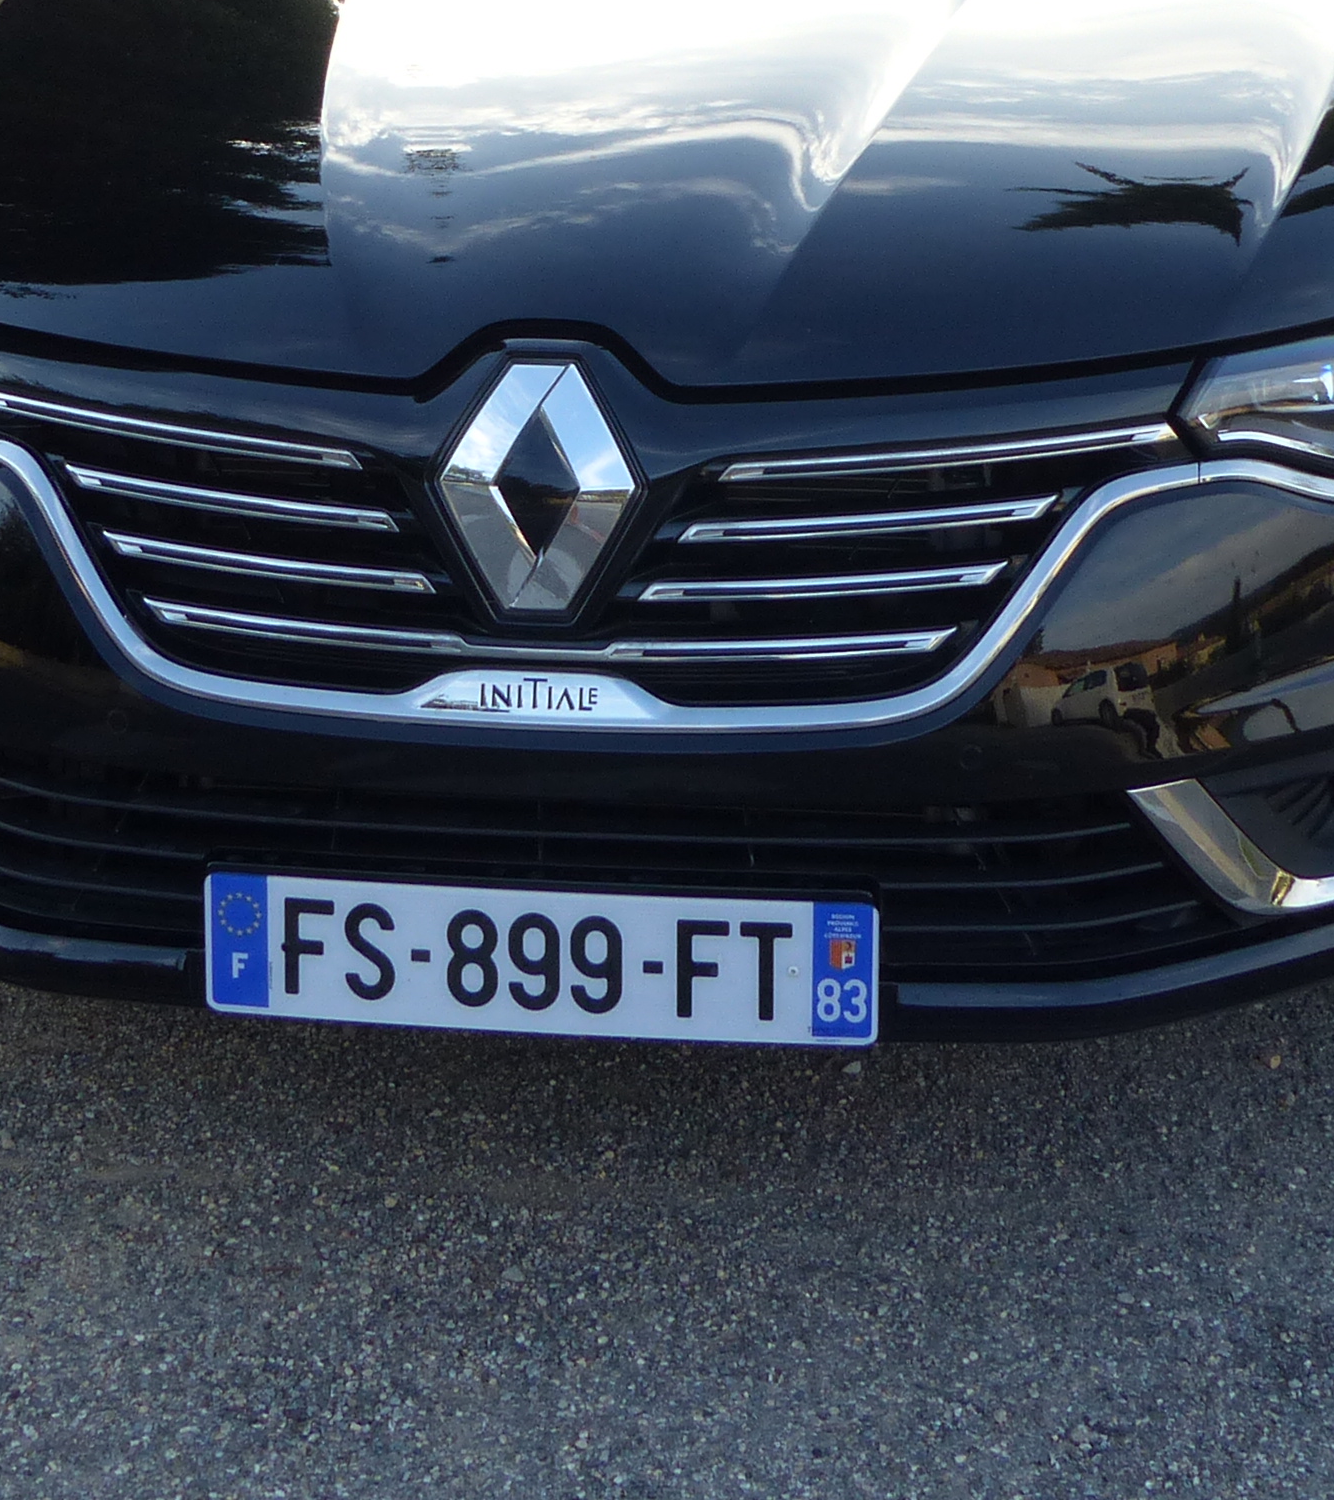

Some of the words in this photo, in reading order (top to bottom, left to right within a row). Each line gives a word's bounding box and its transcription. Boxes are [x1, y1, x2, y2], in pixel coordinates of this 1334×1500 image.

[480, 677, 598, 711] INITIALE
[232, 952, 249, 979] F
[282, 897, 794, 1021] FS-899-FT
[817, 978, 867, 1023] 83
